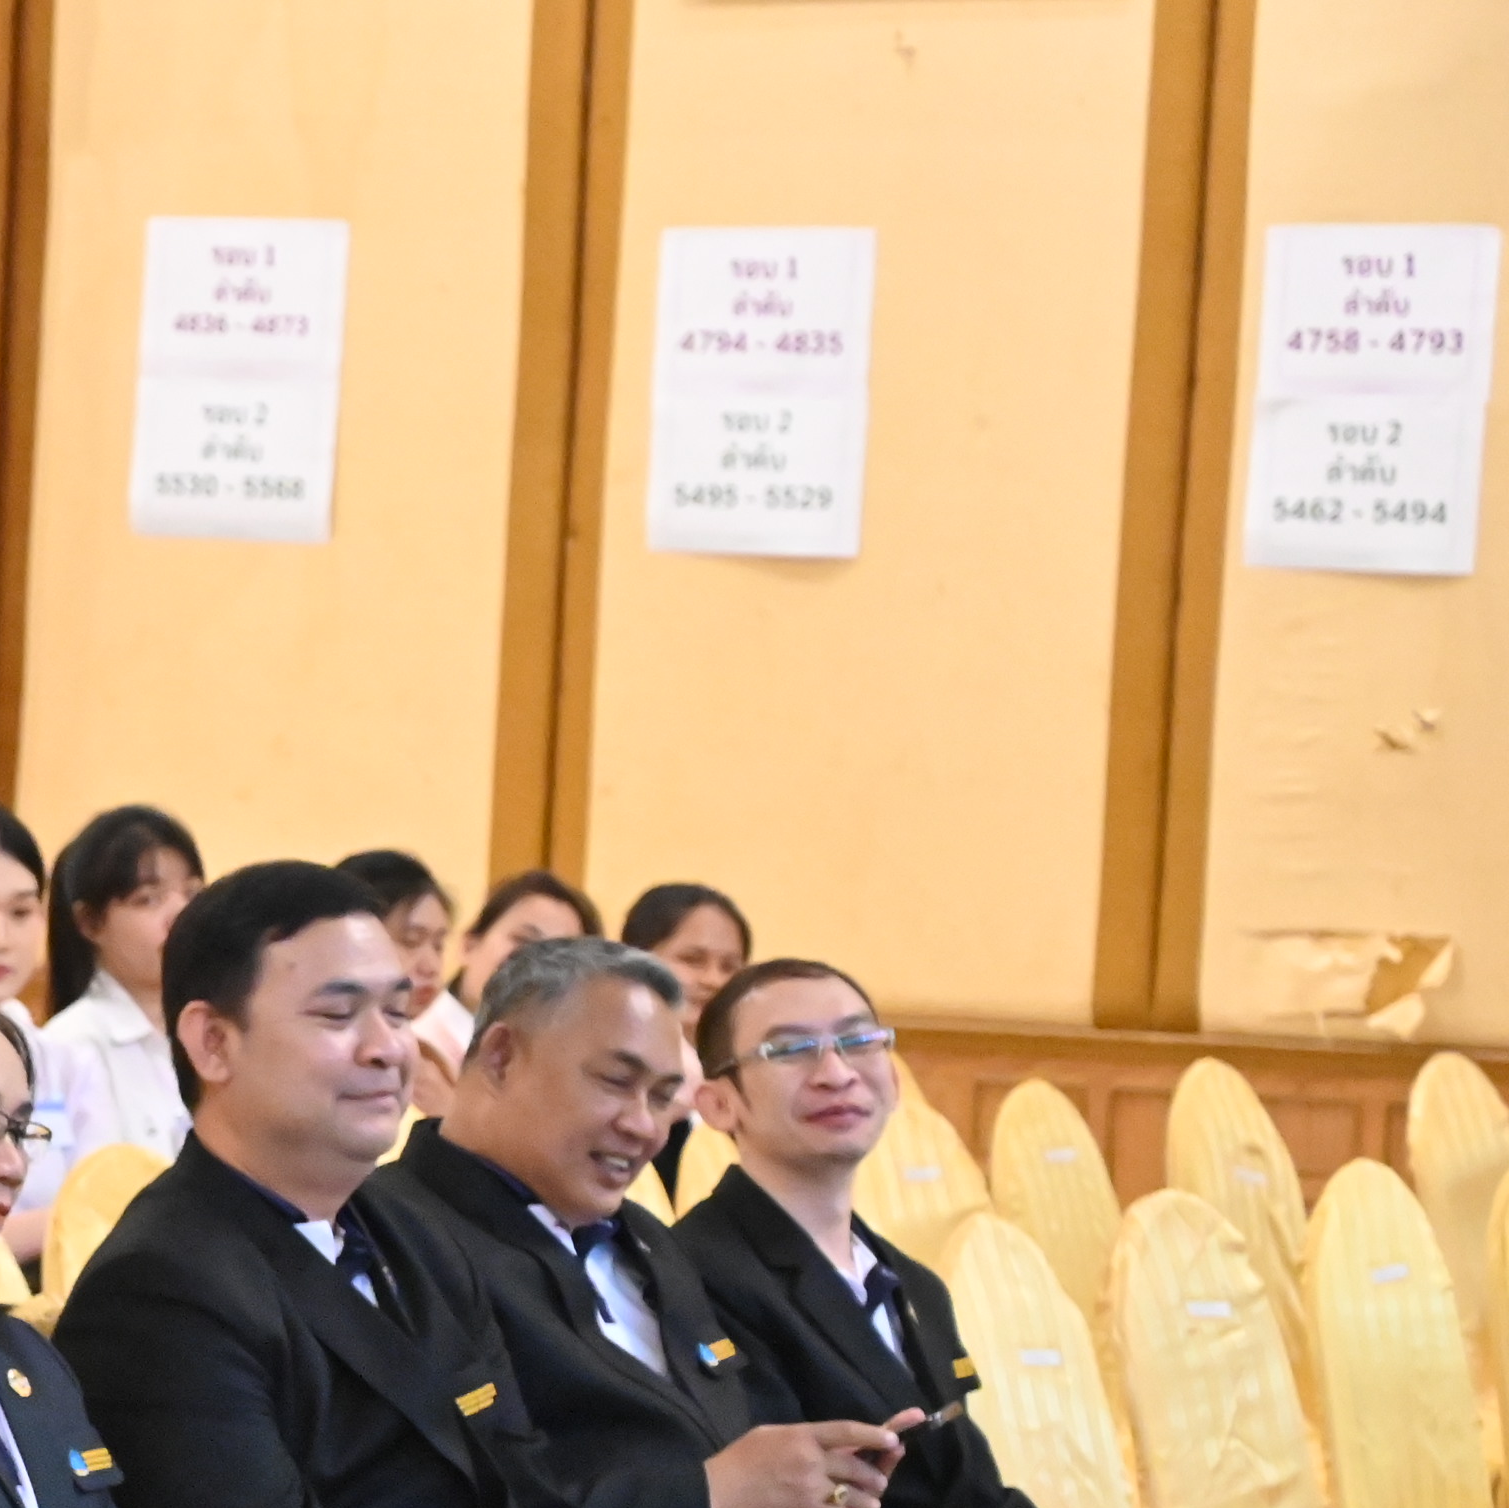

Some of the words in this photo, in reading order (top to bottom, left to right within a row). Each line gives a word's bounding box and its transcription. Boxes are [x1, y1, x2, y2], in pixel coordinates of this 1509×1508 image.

[787, 257, 797, 280] 1
[1342, 256, 1393, 277] รอบ
[1406, 253, 1415, 277] 1
[1344, 289, 1410, 317] ลำดับ
[1287, 329, 1360, 353] 4758
[1389, 329, 1464, 354] 4793
[778, 410, 792, 434] 2
[1328, 423, 1378, 445] รอบ
[1387, 421, 1402, 446] 2
[1327, 456, 1397, 485] ลำดับ
[1274, 499, 1343, 523] 5462
[1374, 500, 1447, 524] 5494
